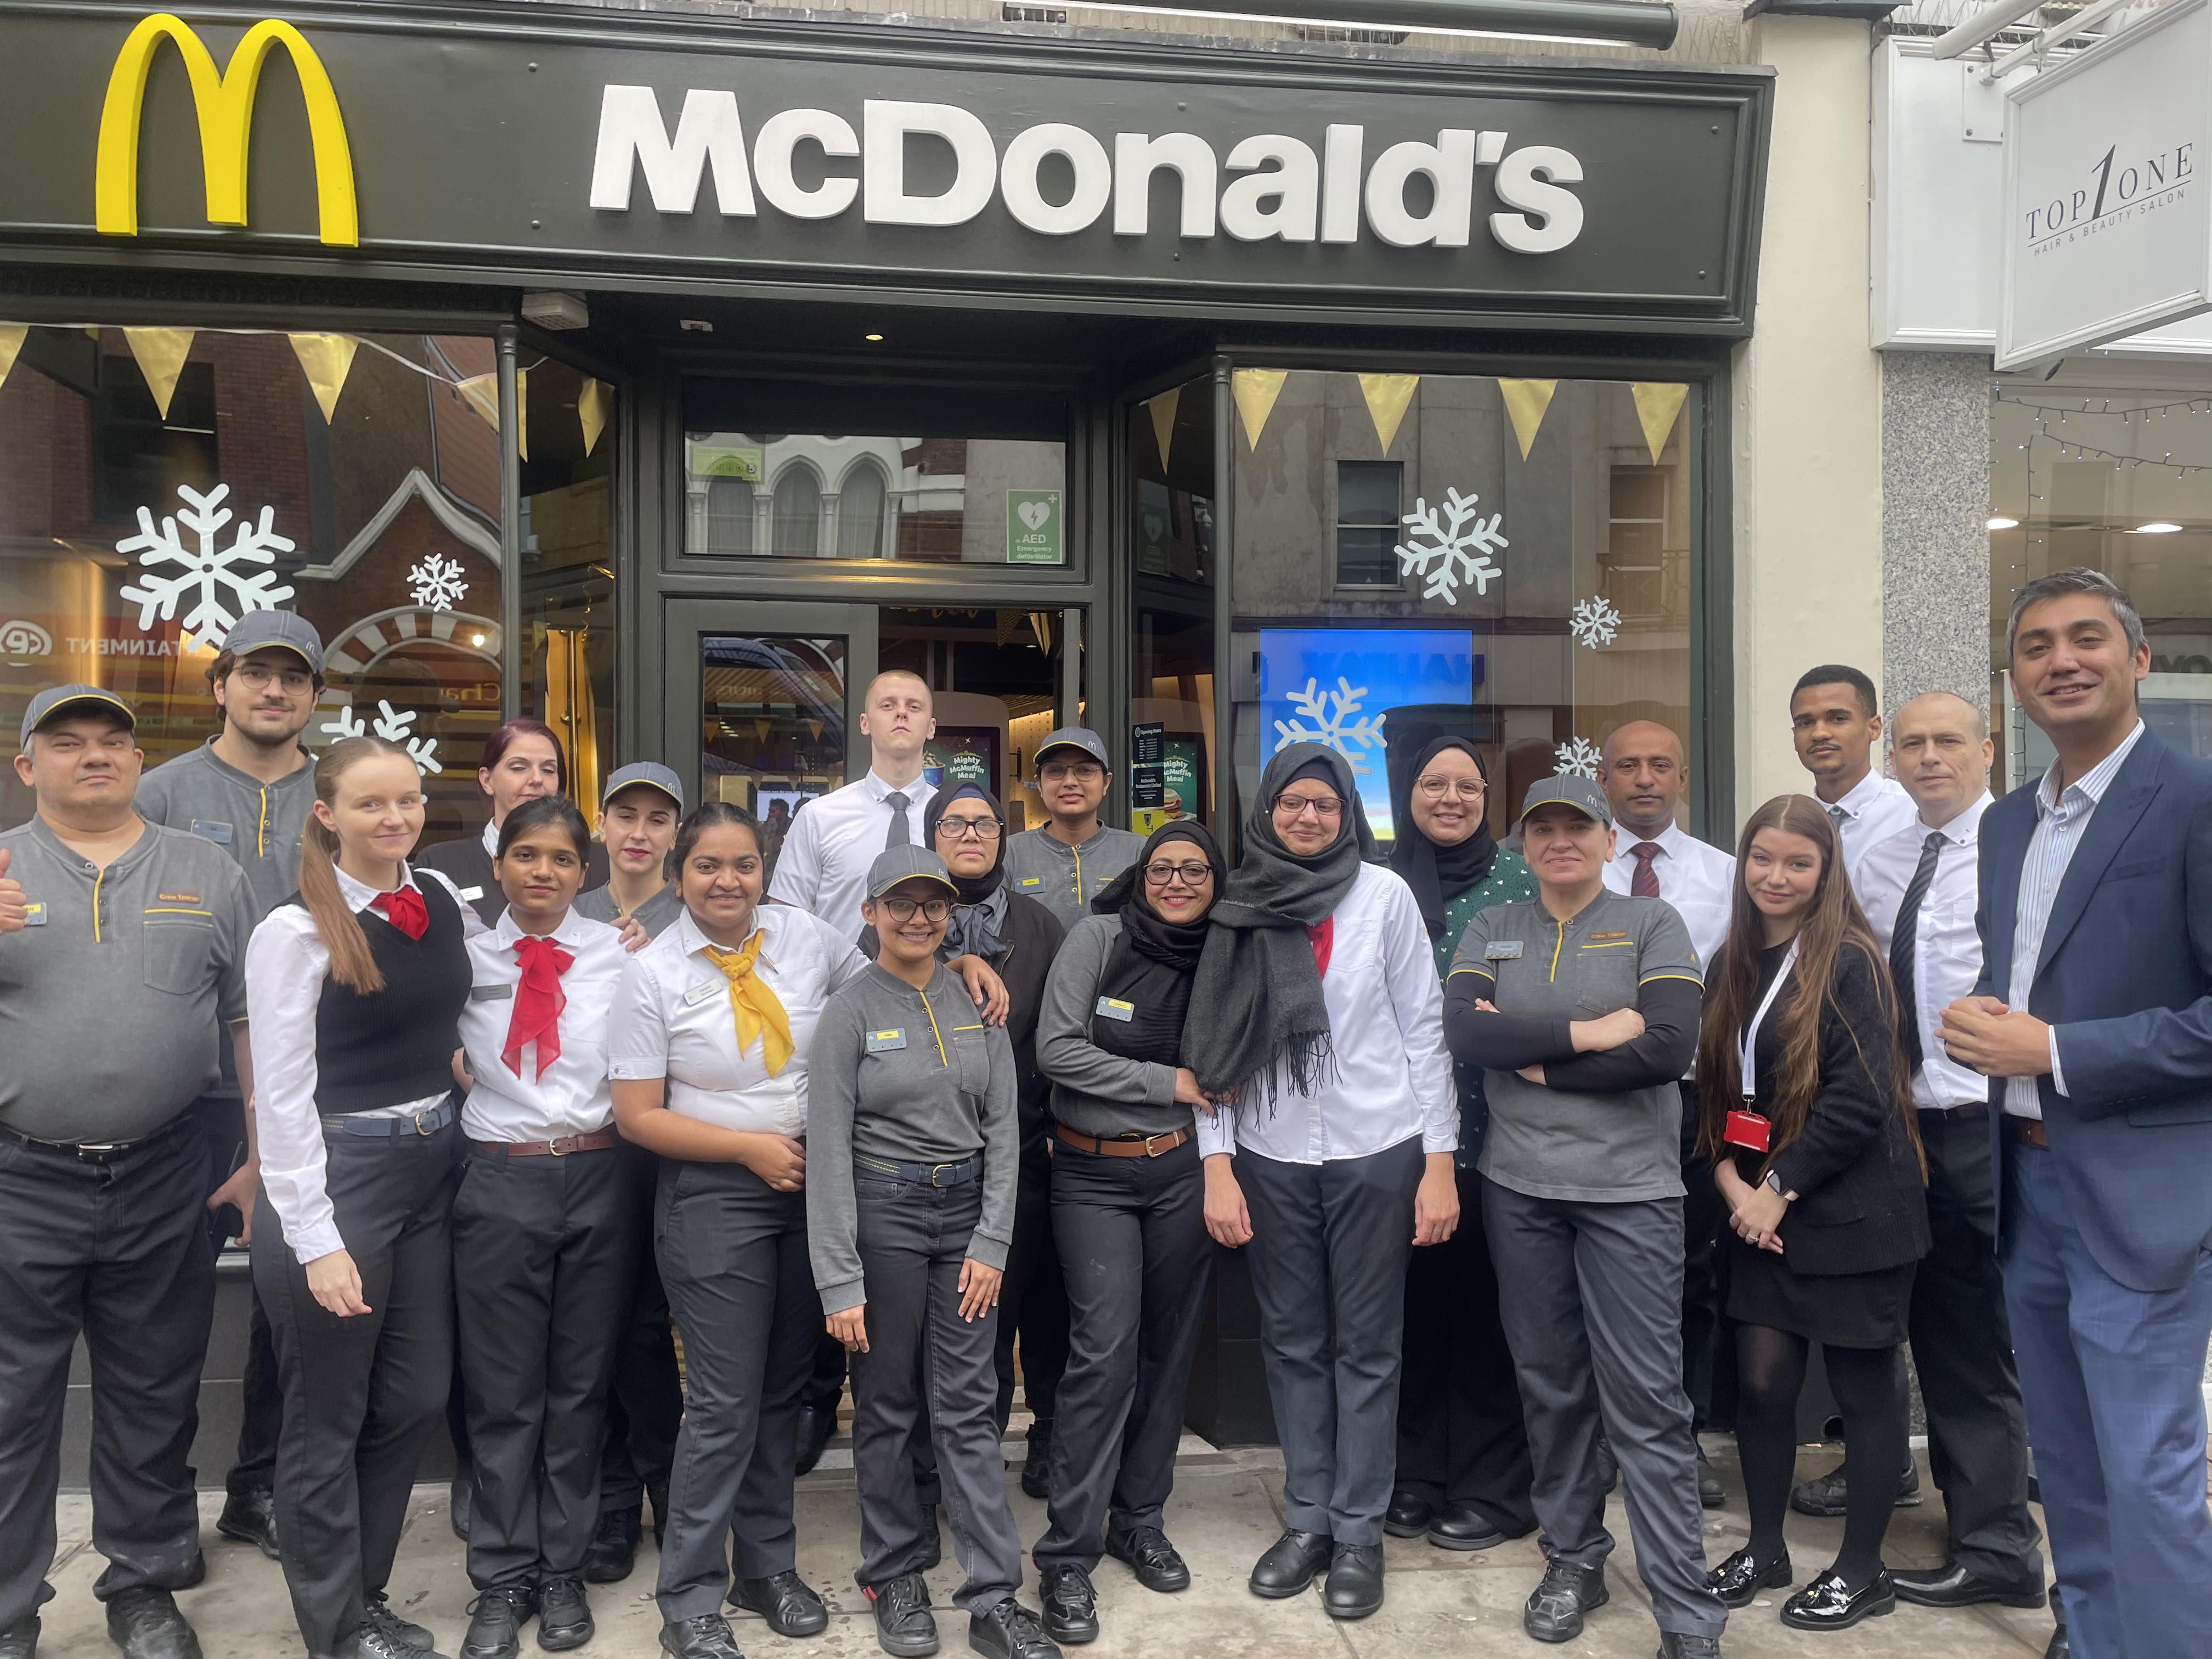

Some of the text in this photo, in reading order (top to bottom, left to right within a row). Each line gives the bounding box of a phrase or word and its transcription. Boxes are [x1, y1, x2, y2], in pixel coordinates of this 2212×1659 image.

[590, 84, 1584, 255] McDonald's
[2025, 143, 2192, 240] TOP 1 ONE
[2034, 188, 2185, 256] HAIR & BEAUTY SALON
[748, 465, 756, 473] 5
[1022, 534, 1046, 543] AED
[953, 756, 980, 765] Mighty
[1163, 760, 1188, 769] Mighty
[949, 765, 984, 774] McMuffin
